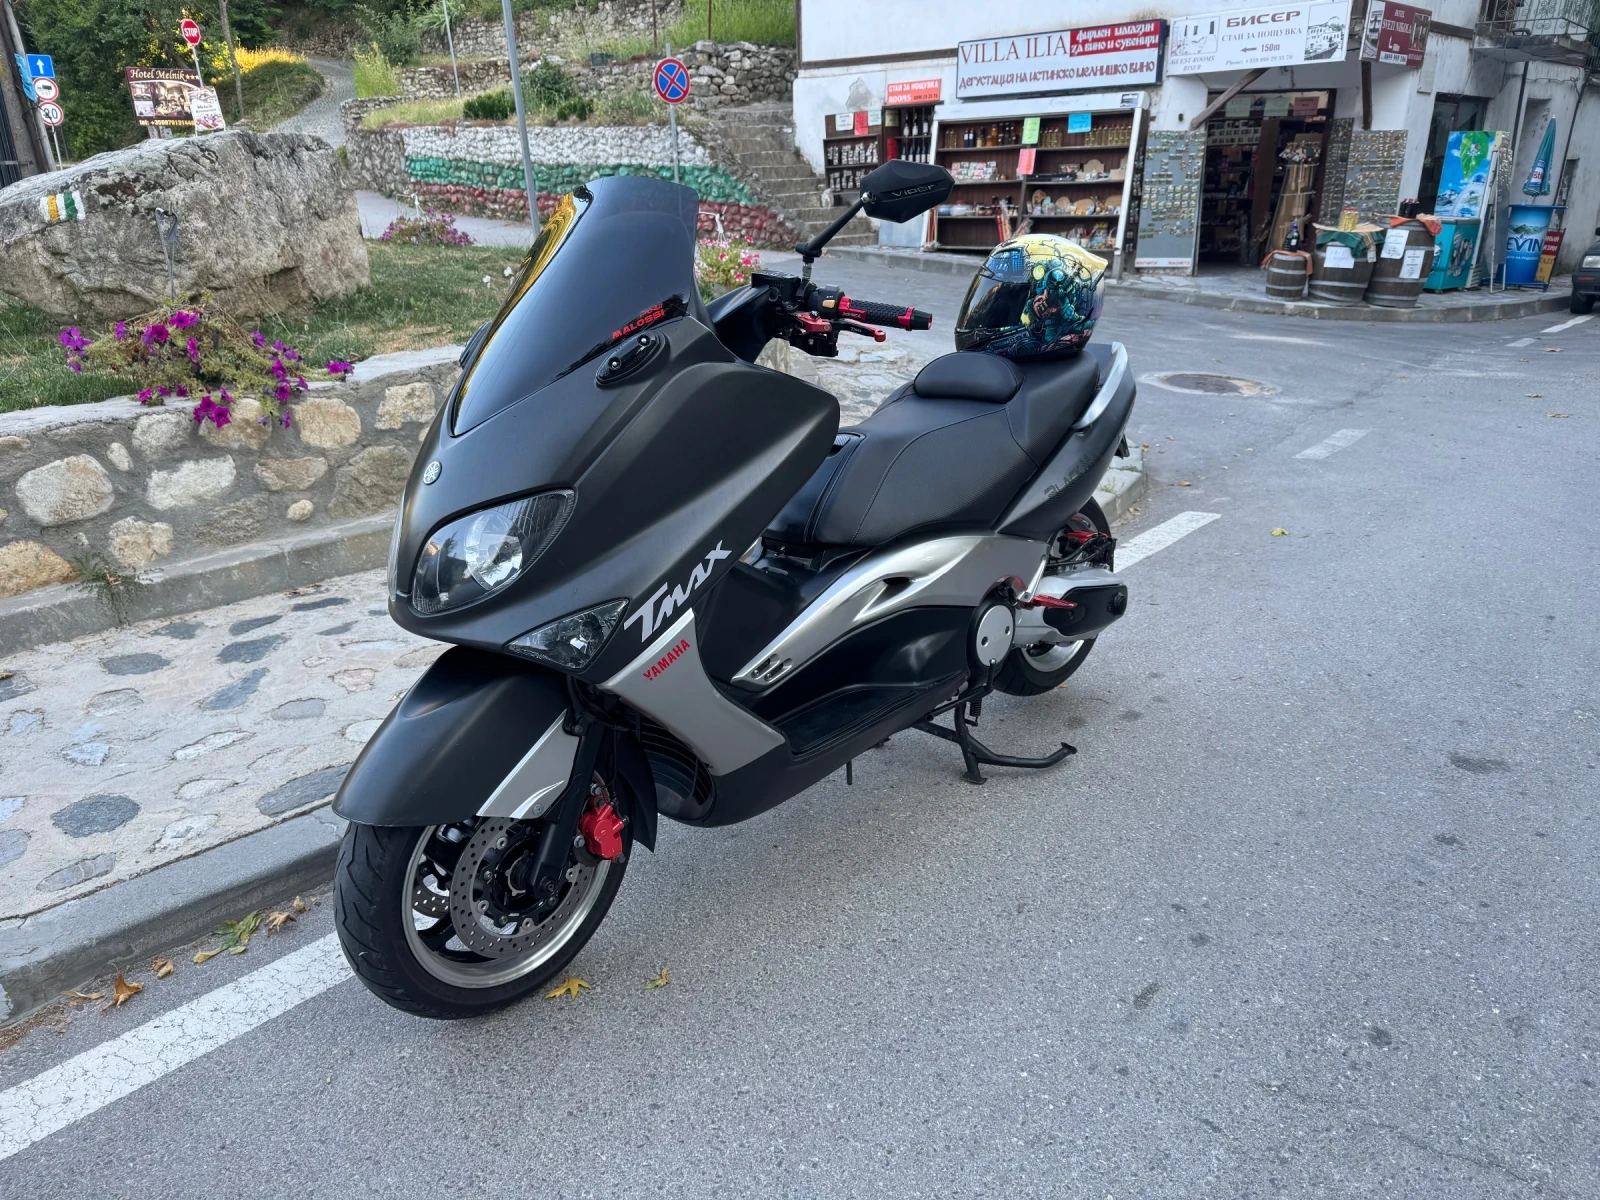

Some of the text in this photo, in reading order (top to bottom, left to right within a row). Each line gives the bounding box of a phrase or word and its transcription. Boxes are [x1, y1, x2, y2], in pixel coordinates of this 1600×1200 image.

[1226, 10, 1300, 28] БИСЕР
[184, 28, 198, 37] STOP
[1221, 28, 1302, 42] СТАИ ЗА НОЩУВКА
[960, 34, 1068, 64] VILLA ILIA
[1261, 43, 1280, 52] 150m
[130, 68, 188, 82] Hotel Melnik
[1016, 72, 1028, 83] НА
[1129, 61, 1155, 74] ВИНО
[888, 80, 939, 92] СТАИ ЗА НОЩУВКА
[888, 93, 912, 103] ROOMS
[1507, 238, 1544, 252] EVIN
[612, 308, 664, 340] MALOSSI
[642, 639, 690, 681] YAMAHA
